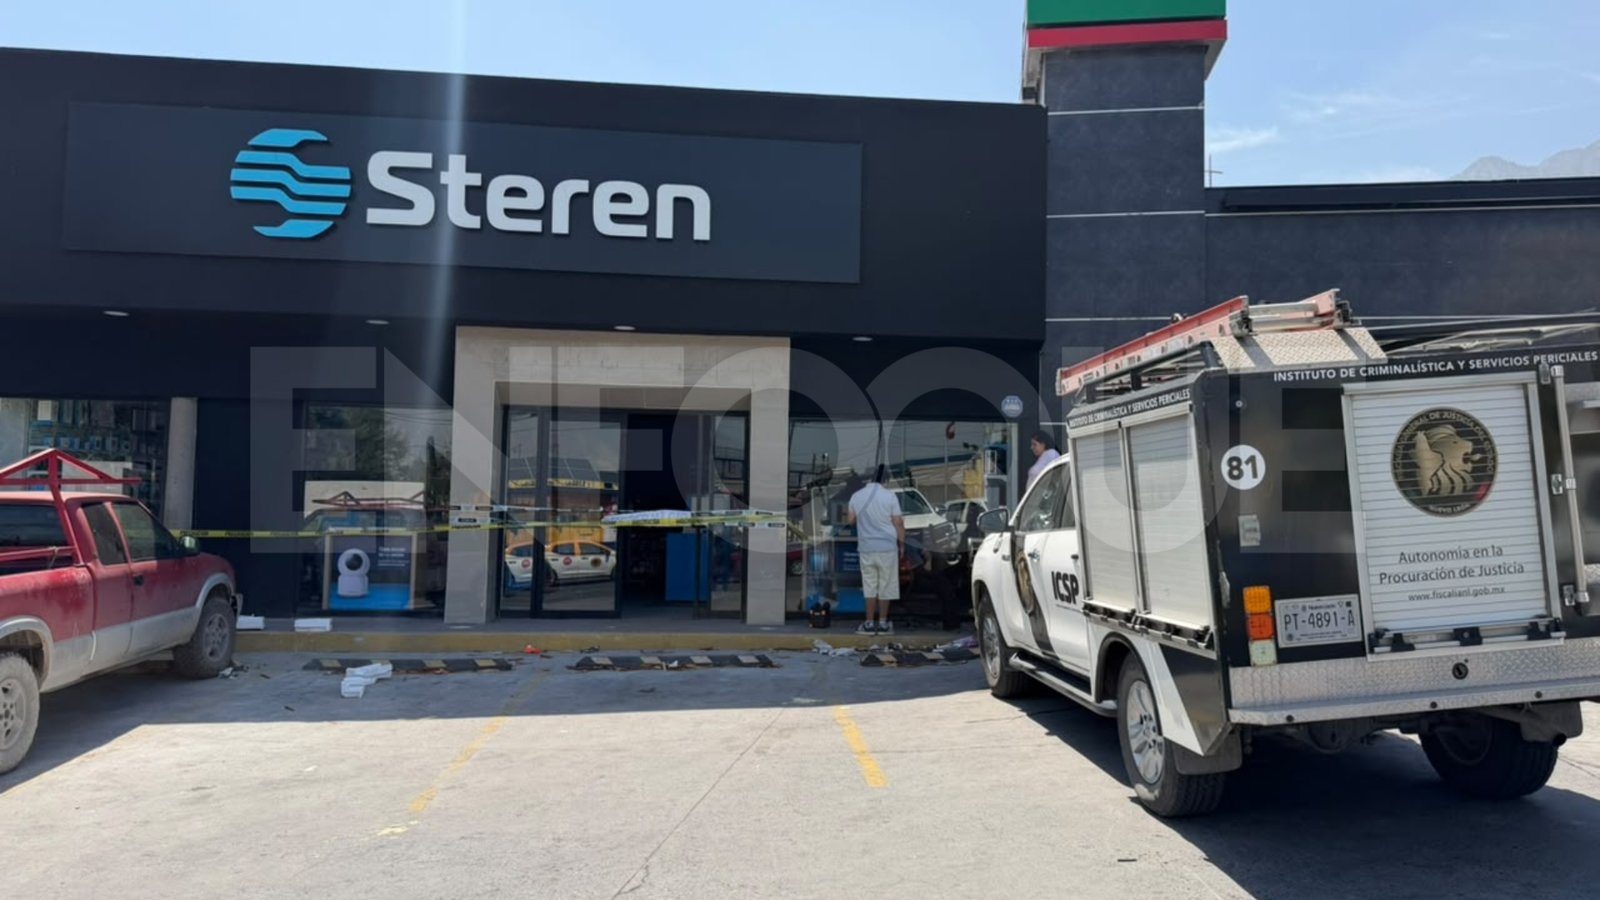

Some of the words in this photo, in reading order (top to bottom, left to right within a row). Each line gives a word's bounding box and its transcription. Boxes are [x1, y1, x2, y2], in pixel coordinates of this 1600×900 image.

[365, 149, 711, 241] Steren
[1273, 369, 1337, 382] INSTITUTO
[1340, 367, 1356, 378] DE
[1359, 360, 1455, 376] CRIMINALÍSTICA
[1457, 360, 1466, 370] Y
[1469, 356, 1530, 369] SERVICIOS
[1533, 351, 1598, 364] PERICIALES
[1132, 397, 1158, 412] SERVICIOS
[1158, 388, 1191, 406] PERICIALES
[1227, 454, 1258, 480] 81
[1398, 545, 1470, 564] Autonomía
[1473, 547, 1489, 559] en
[1492, 544, 1504, 557] la
[1379, 566, 1456, 585] Procuración
[1458, 565, 1475, 579] de
[1478, 561, 1525, 577] Justicia
[1051, 570, 1079, 605] ICSP
[1284, 609, 1355, 631] PT-4891-A
